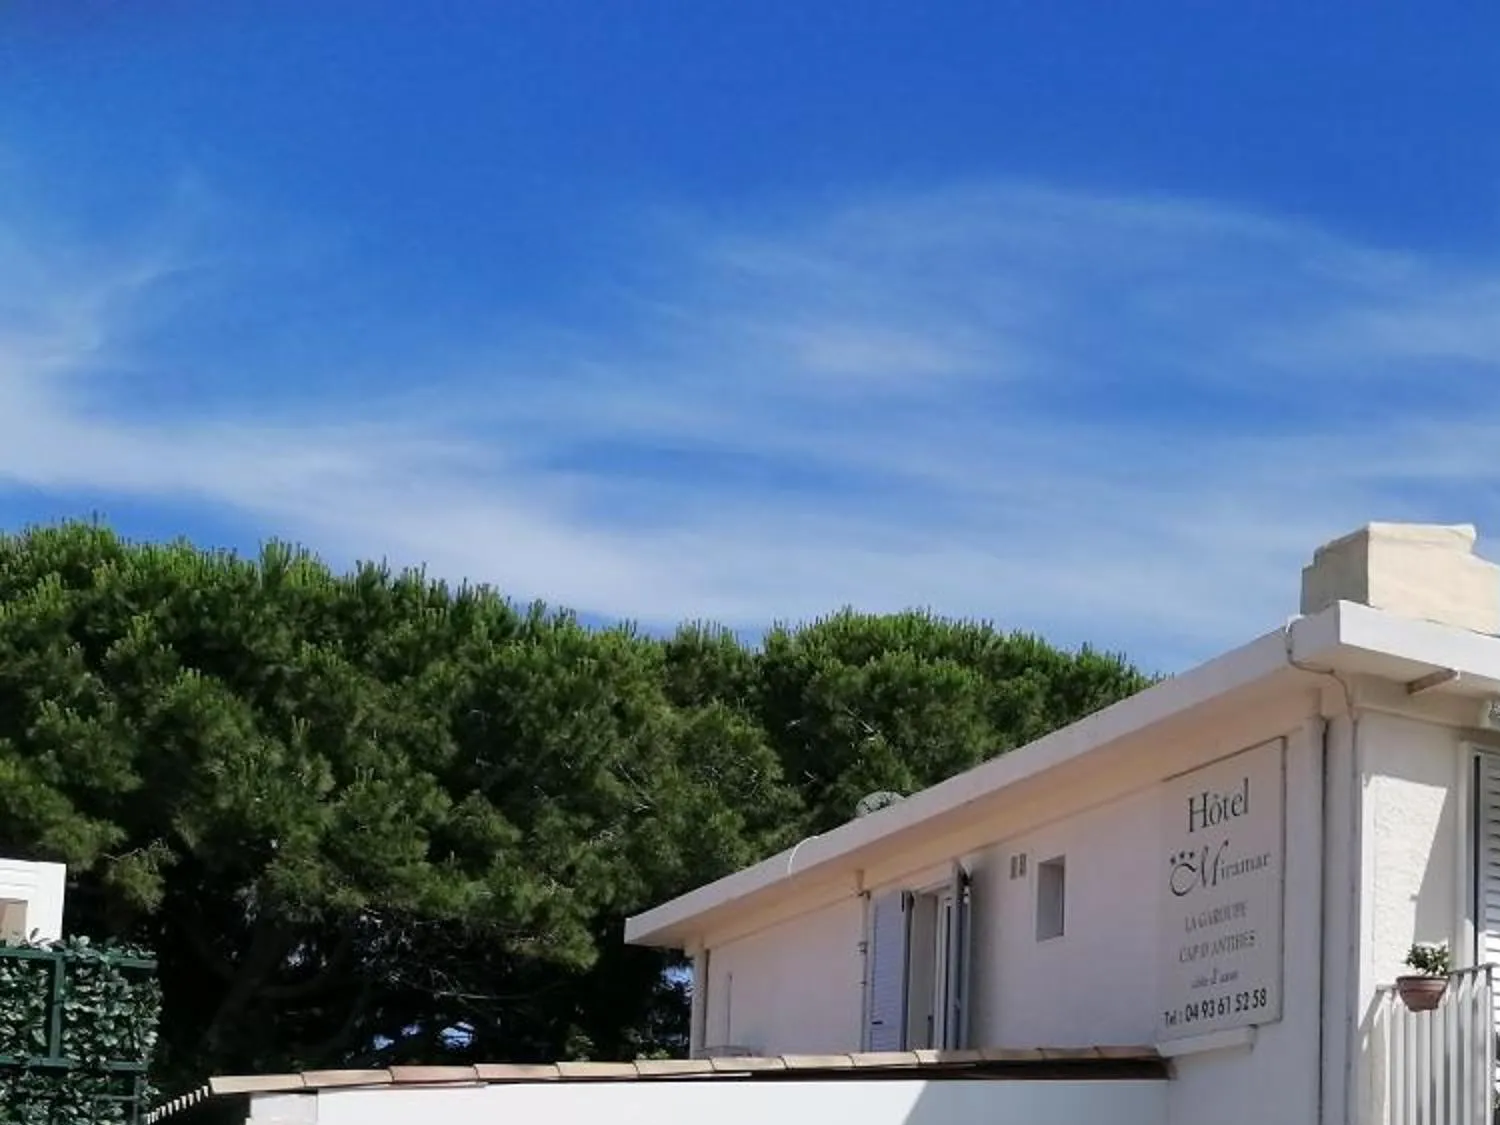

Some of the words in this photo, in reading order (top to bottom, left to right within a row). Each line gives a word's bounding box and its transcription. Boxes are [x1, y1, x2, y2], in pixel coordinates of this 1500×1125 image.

[1188, 777, 1250, 833] Hôtel
[1169, 839, 1272, 897] Miramar
[1185, 1003, 1199, 1023] 04
[1201, 999, 1215, 1019] 93
[1217, 995, 1231, 1016] 61
[1235, 991, 1249, 1012] 52
[1252, 987, 1267, 1009] 58
